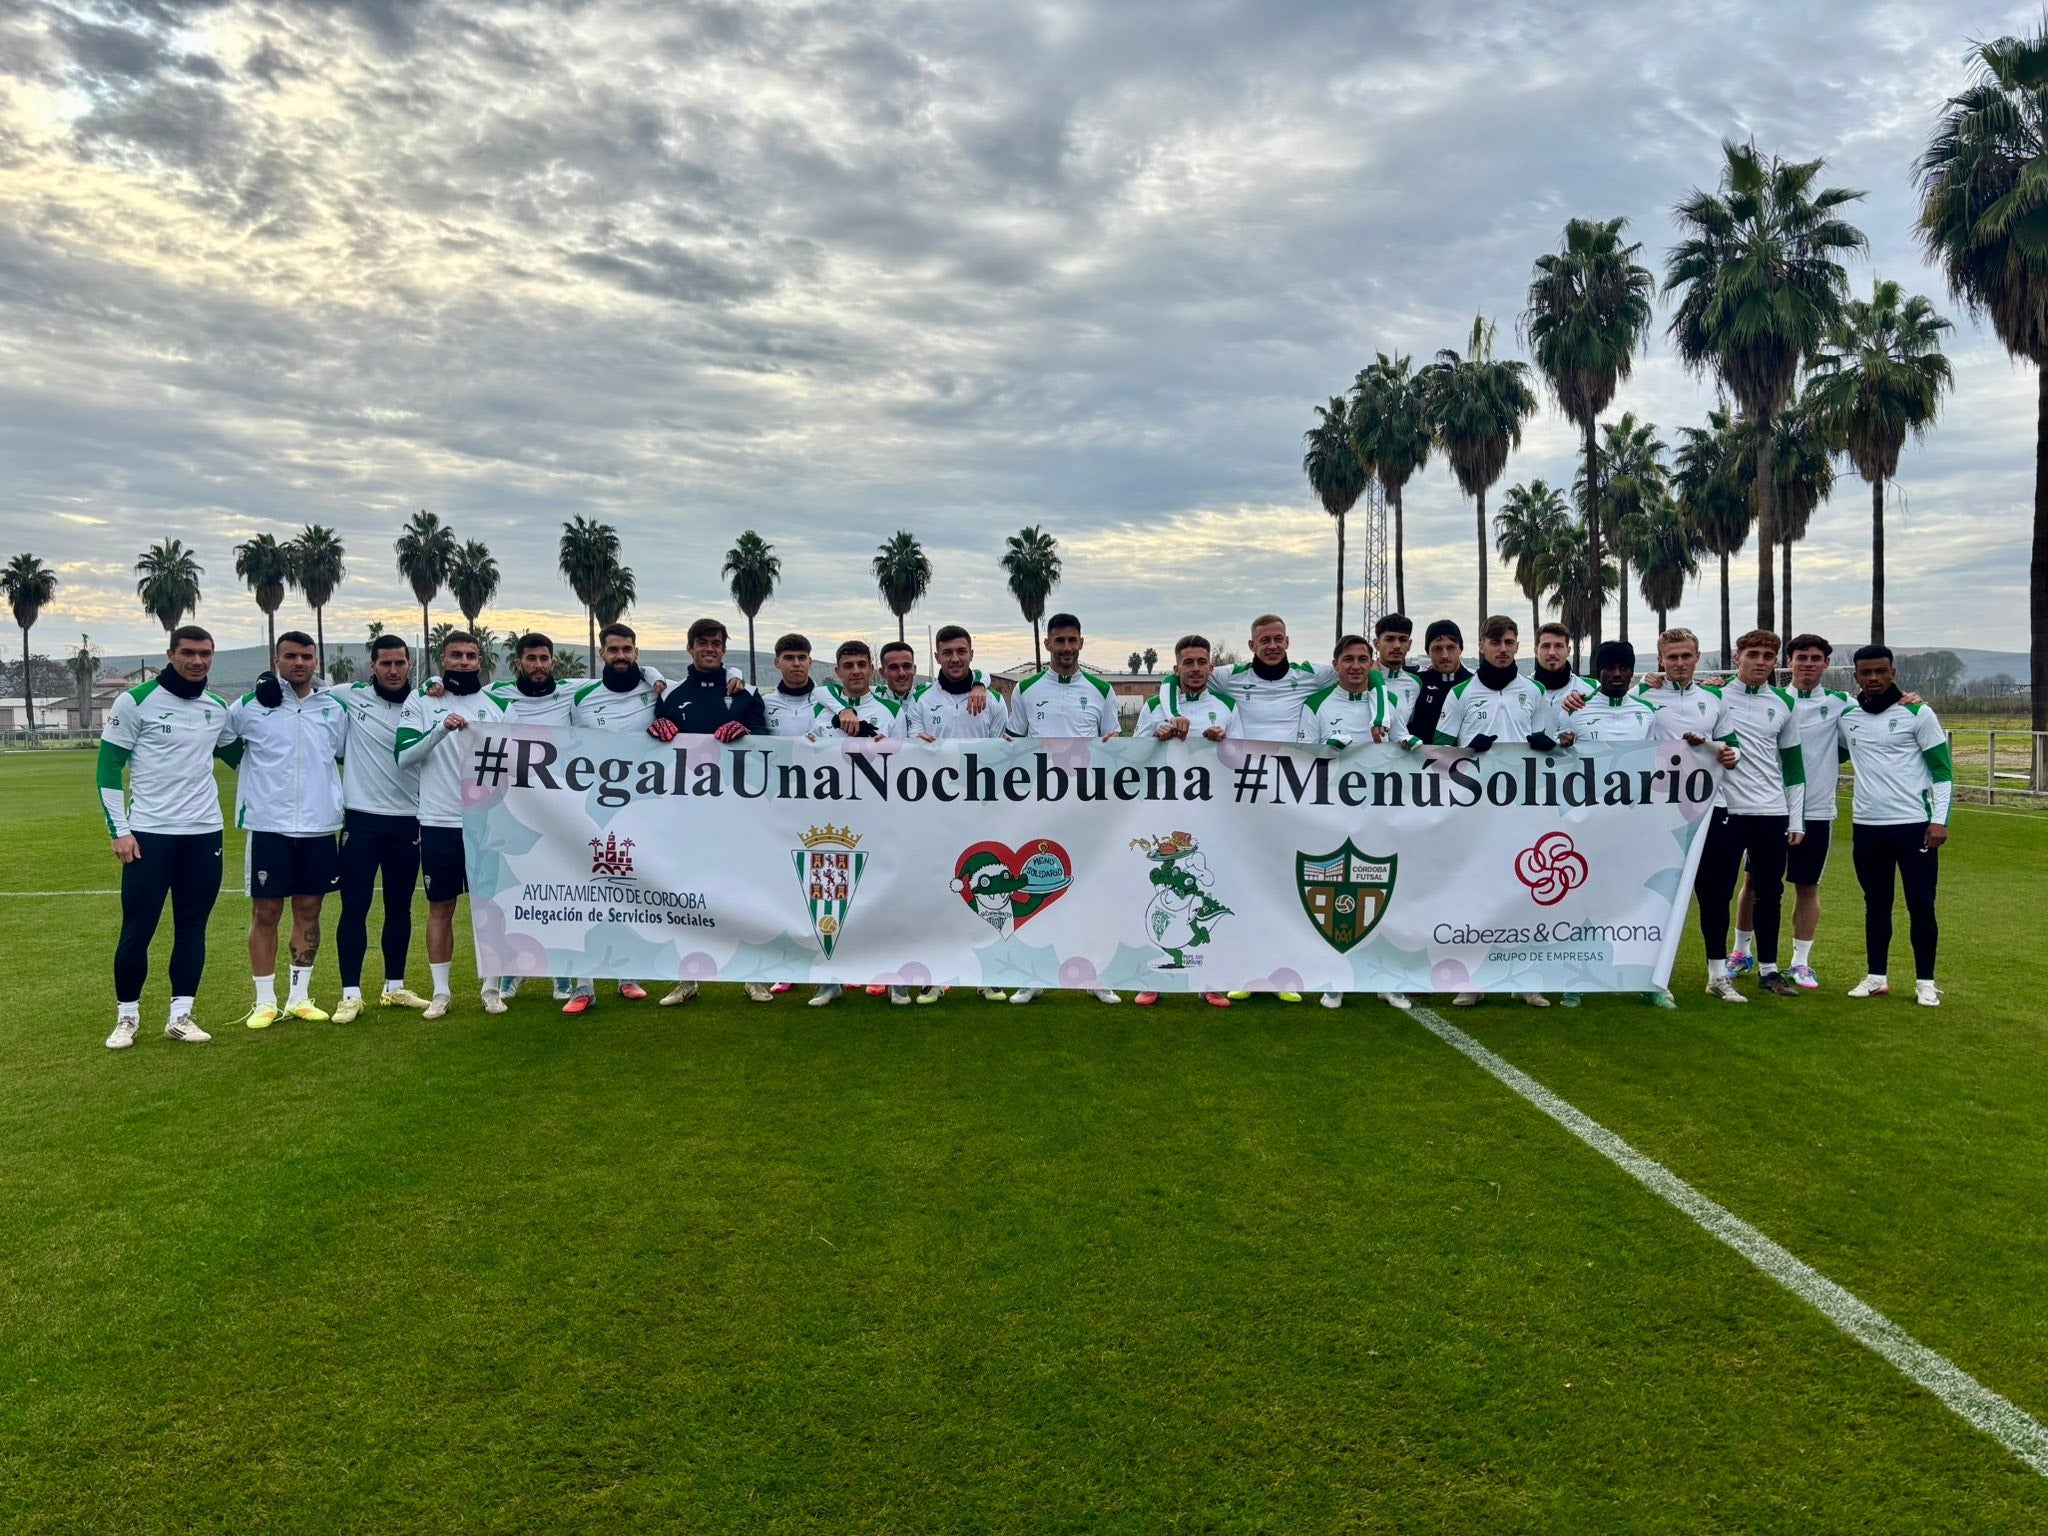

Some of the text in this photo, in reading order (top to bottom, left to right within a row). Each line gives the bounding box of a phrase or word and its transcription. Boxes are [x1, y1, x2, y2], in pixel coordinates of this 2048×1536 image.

[932, 716, 941, 724] 20
[1037, 712, 1045, 720] 21
[1477, 711, 1487, 720] 30
[597, 717, 606, 726] 15
[161, 724, 172, 734] 18
[474, 736, 1714, 807] #RegalaUnaNochebuena #MenúSolidario
[522, 884, 707, 910] AYUNTAMIENTO DE CORDOBA
[514, 905, 716, 928] Delegación de Servicios Sociales
[1433, 923, 1530, 944] Cabezas
[1552, 921, 1662, 942] Carmona
[1488, 951, 1604, 962] GRUPO DE EMPRESAS
